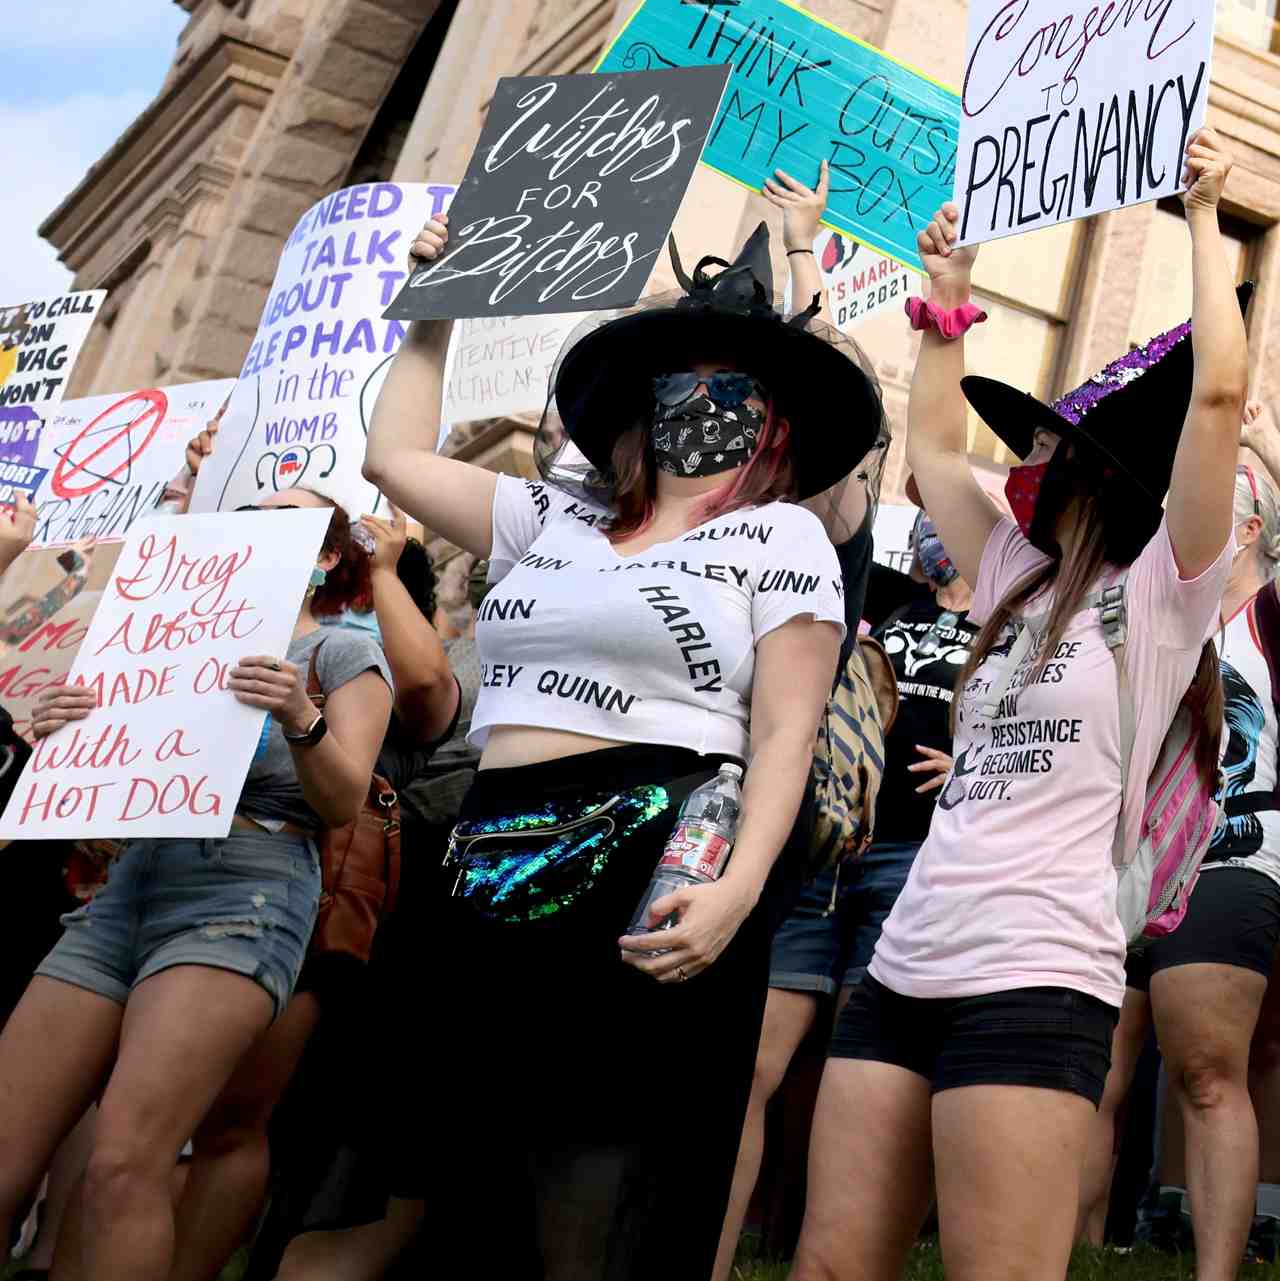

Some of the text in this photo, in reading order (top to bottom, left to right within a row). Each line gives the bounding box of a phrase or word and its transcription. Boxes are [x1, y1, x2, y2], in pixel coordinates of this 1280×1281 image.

[1041, 76, 1078, 110] TO
[484, 81, 694, 182] Witches
[961, 61, 1205, 240] PREGNANCY
[709, 88, 924, 228] MY BOX
[312, 185, 402, 232] NEED
[427, 186, 454, 215] T
[516, 181, 601, 212] FOR
[301, 230, 402, 276] TALK
[409, 214, 658, 305] Bitches
[47, 295, 94, 318] CALL
[264, 273, 352, 326] ABOUT
[838, 274, 907, 326] 02.2021
[16, 344, 67, 372] VAG
[242, 318, 405, 378] ELEPHAN
[274, 362, 354, 404] in the
[265, 412, 337, 446] WOMB
[116, 534, 252, 616] Greg
[639, 585, 723, 693] HARLEY
[73, 664, 180, 708] MADE
[156, 729, 200, 762] a
[991, 719, 1082, 749] RESISTANCE
[981, 749, 1053, 776] BECOMES
[19, 774, 220, 825] HOT DOG
